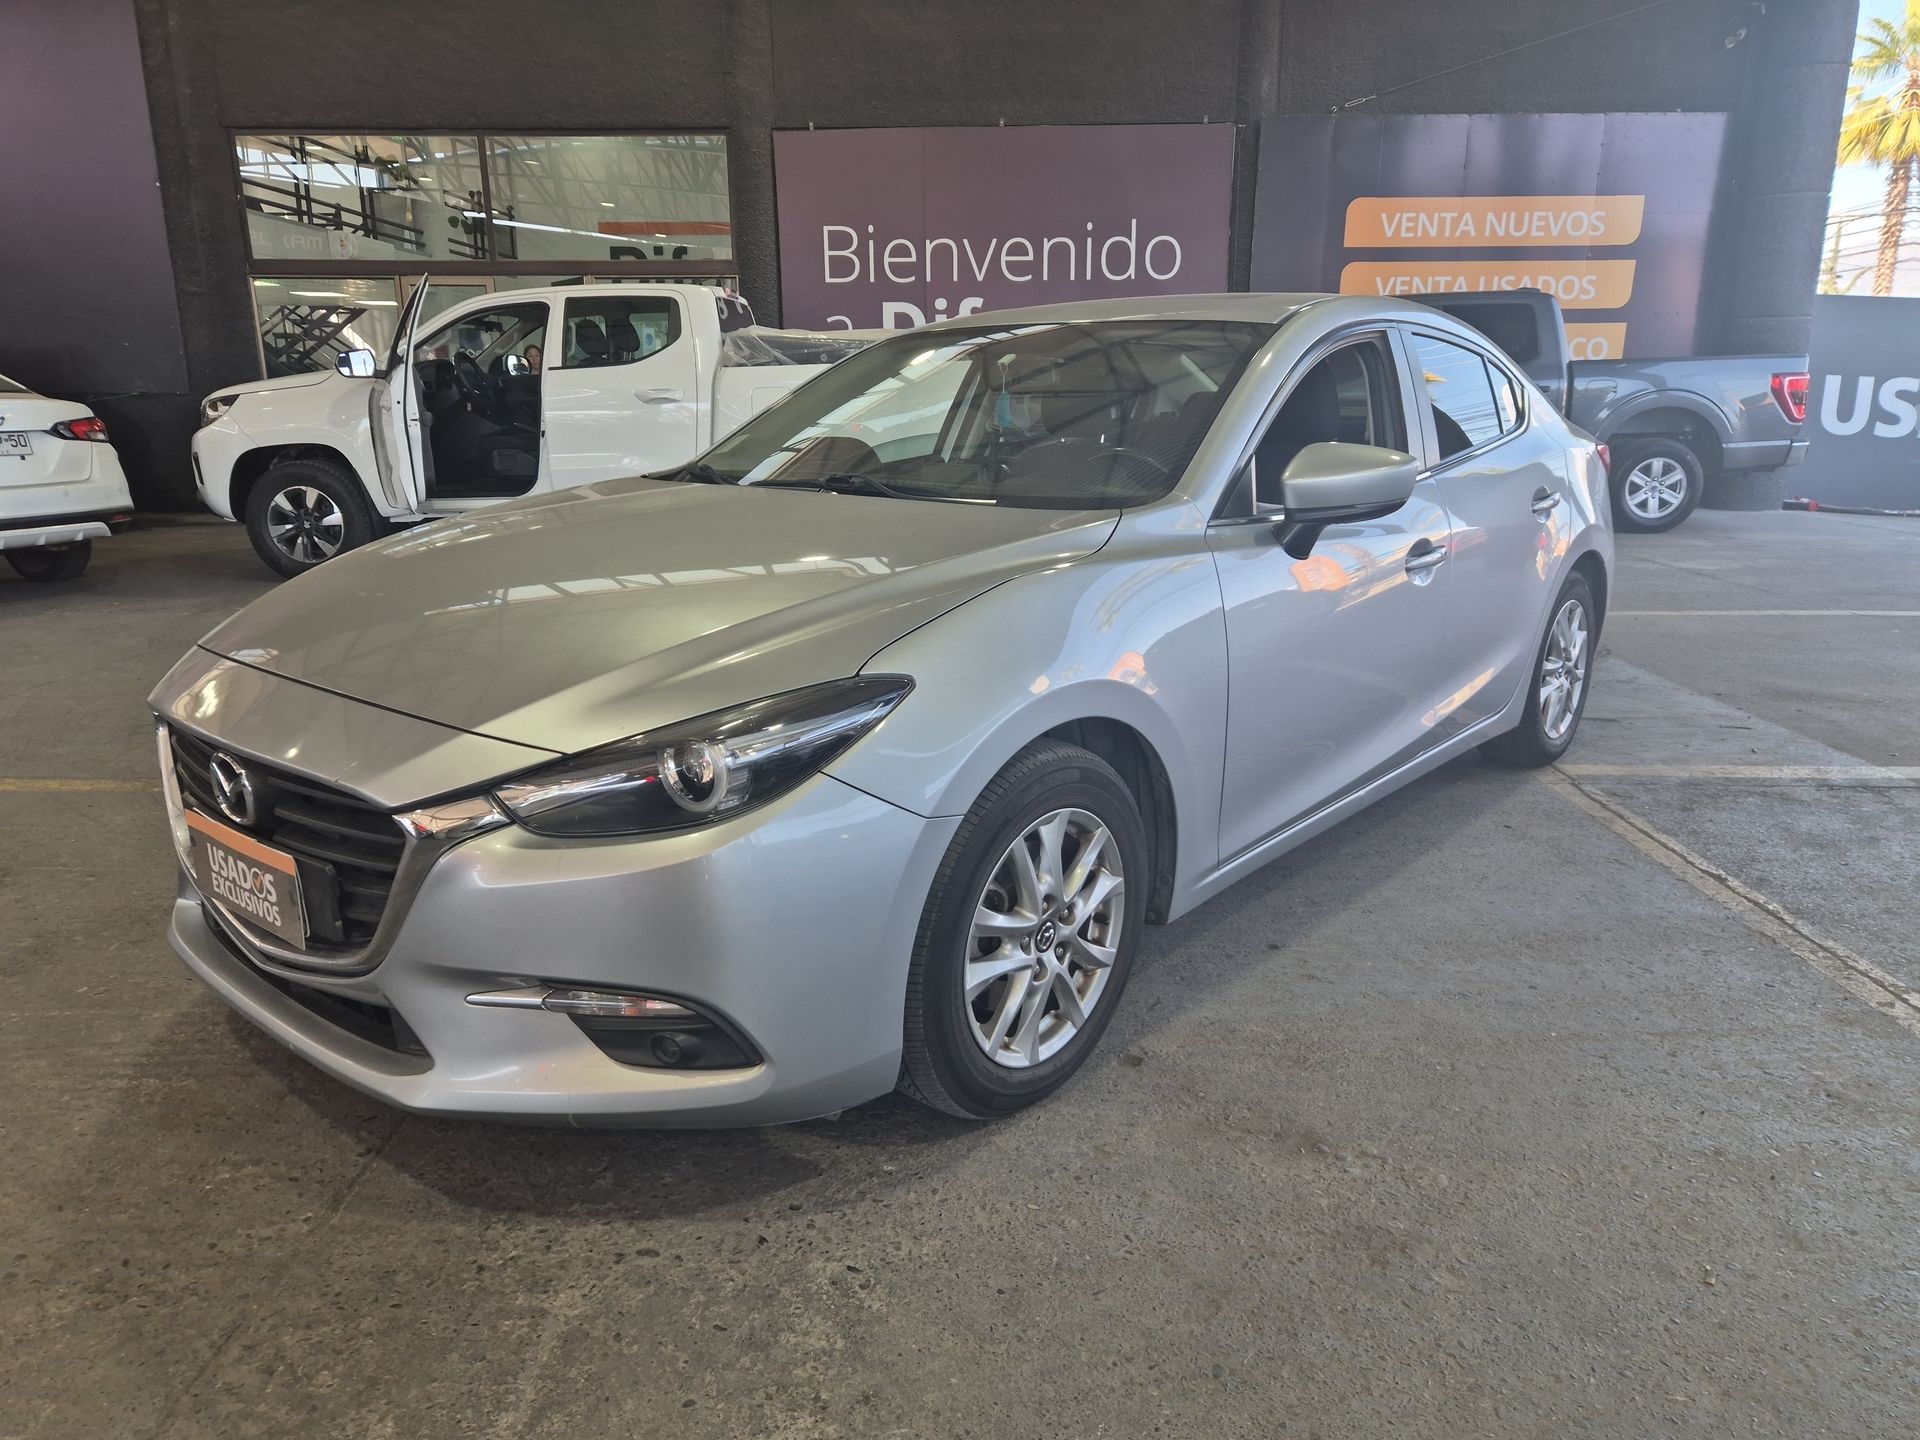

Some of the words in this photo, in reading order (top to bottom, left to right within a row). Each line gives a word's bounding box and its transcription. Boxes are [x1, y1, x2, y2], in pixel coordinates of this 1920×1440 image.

[821, 218, 1182, 284] Bienvenido
[1381, 212, 1476, 238] VENTA
[1484, 210, 1606, 238] NUEVOS
[1375, 276, 1468, 296] VENTA
[1478, 274, 1598, 301] USADOS
[1820, 374, 1920, 439] US
[206, 842, 277, 903] USADOS
[211, 871, 282, 927] EXCLUSIVOS
